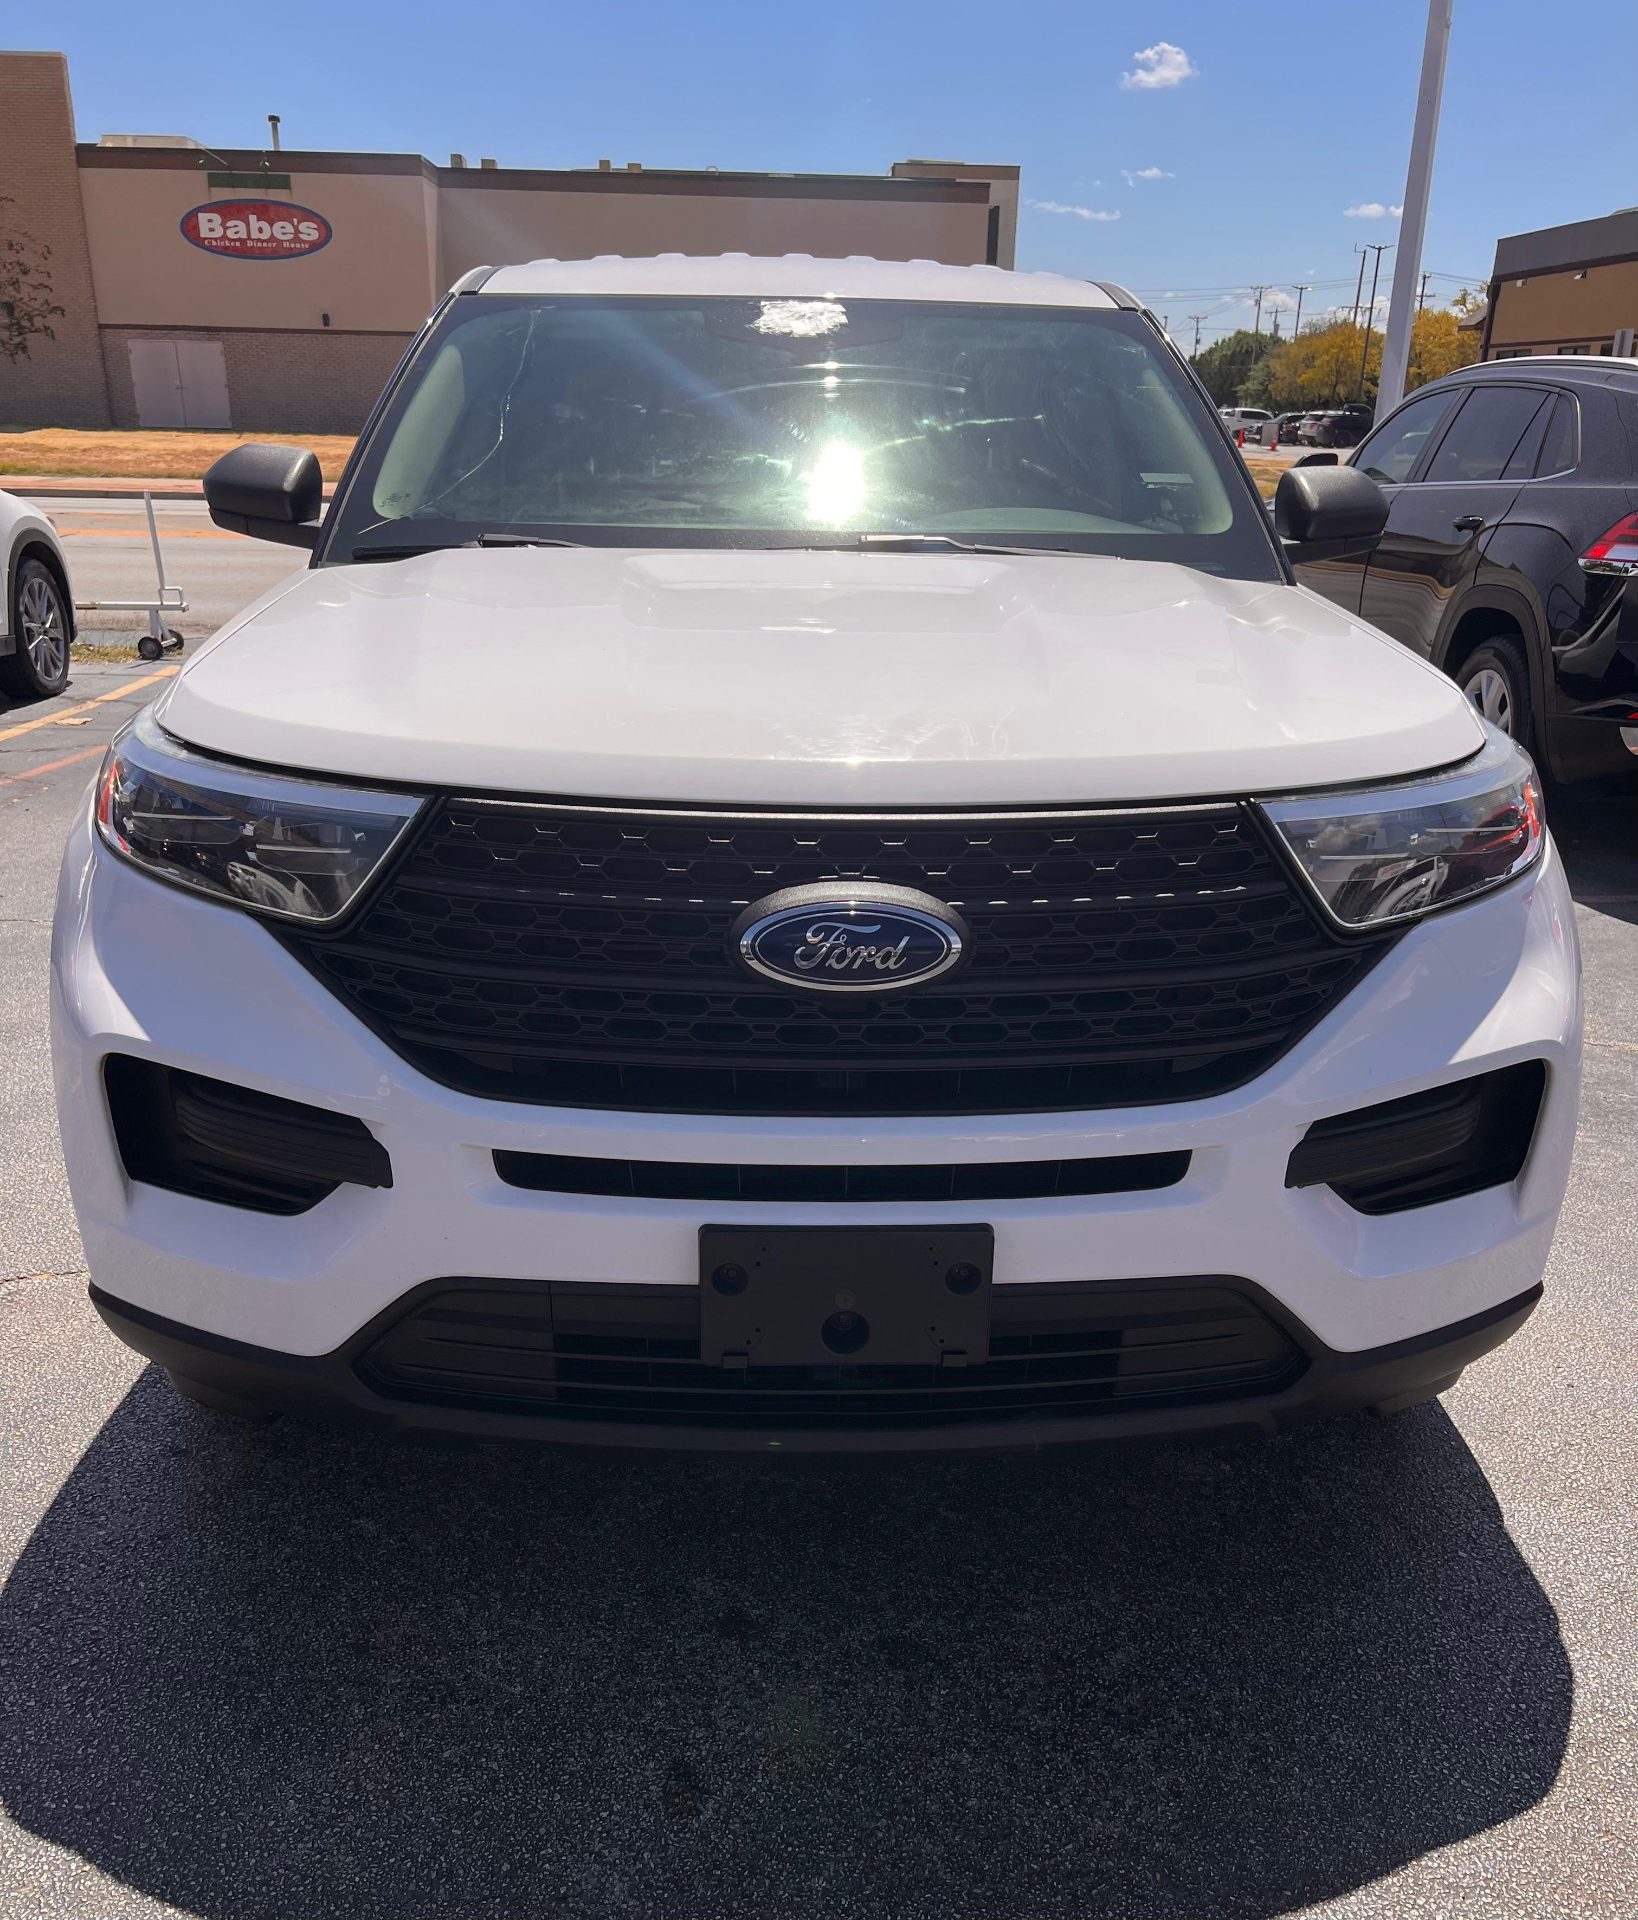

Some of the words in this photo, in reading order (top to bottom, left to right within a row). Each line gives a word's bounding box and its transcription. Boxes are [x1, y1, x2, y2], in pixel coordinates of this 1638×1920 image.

[197, 212, 320, 241] Babe's
[204, 239, 241, 247] Chicken
[247, 240, 277, 248] Dinner
[283, 241, 310, 249] House
[793, 921, 911, 970] Ford
